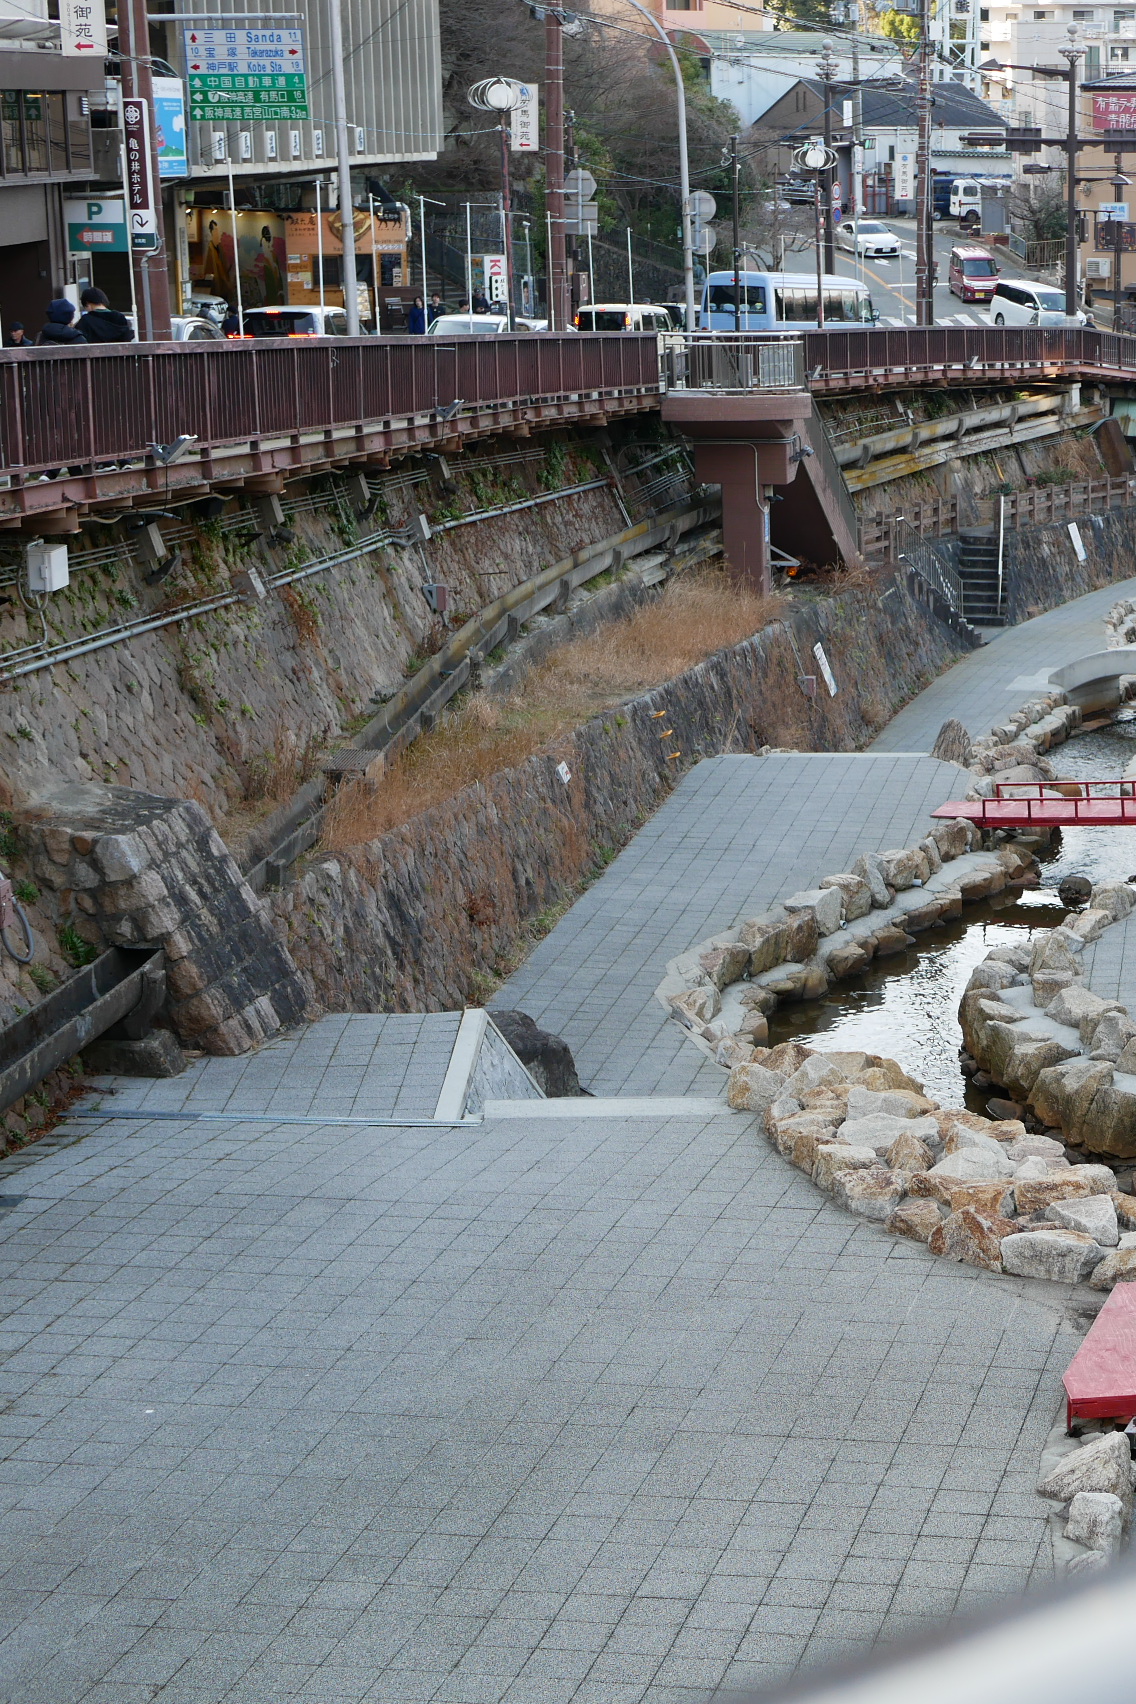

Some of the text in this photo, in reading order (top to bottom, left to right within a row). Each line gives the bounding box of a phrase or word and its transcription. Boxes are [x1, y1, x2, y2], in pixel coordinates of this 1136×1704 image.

[73, 0, 93, 37] 御苑
[203, 32, 236, 43] 三田
[246, 31, 282, 43] Sanda
[190, 47, 199, 55] 10
[246, 47, 284, 58] Takarazuka
[206, 62, 239, 73] 神戸駅
[247, 61, 286, 73] Kobe Sta.
[291, 61, 300, 69] 19
[207, 76, 287, 88] 中国自動車道
[259, 91, 288, 102] 有馬口
[204, 107, 243, 119] 阪神高速
[128, 137, 143, 205] 亀の井ホテル
[86, 202, 103, 221] P
